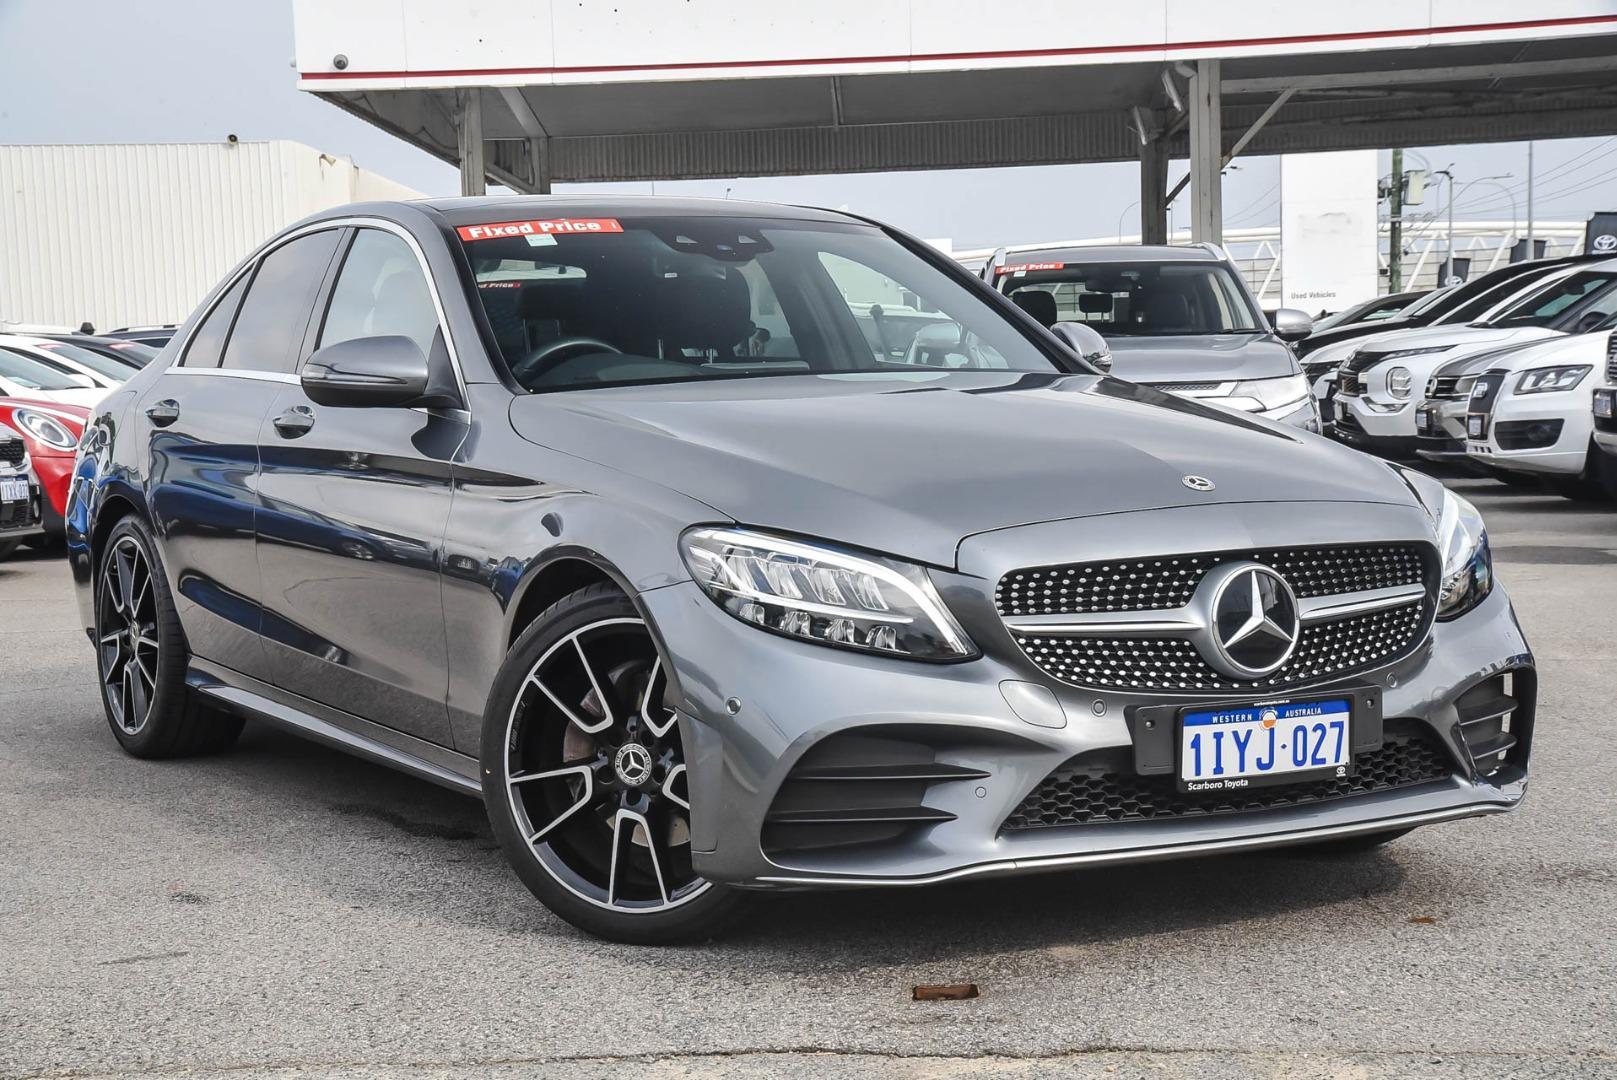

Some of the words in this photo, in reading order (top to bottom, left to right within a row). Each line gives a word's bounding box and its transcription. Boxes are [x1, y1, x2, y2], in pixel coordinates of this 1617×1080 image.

[470, 222, 534, 238] Fixed
[538, 218, 601, 234] Price
[1000, 264, 1026, 273] Fixed
[1308, 290, 1336, 299] Vehicles
[1212, 713, 1253, 724] WESTERN
[1285, 707, 1322, 718] AUSTRALIA
[1187, 780, 1223, 791] Scarboro
[1224, 779, 1248, 789] Toyota
